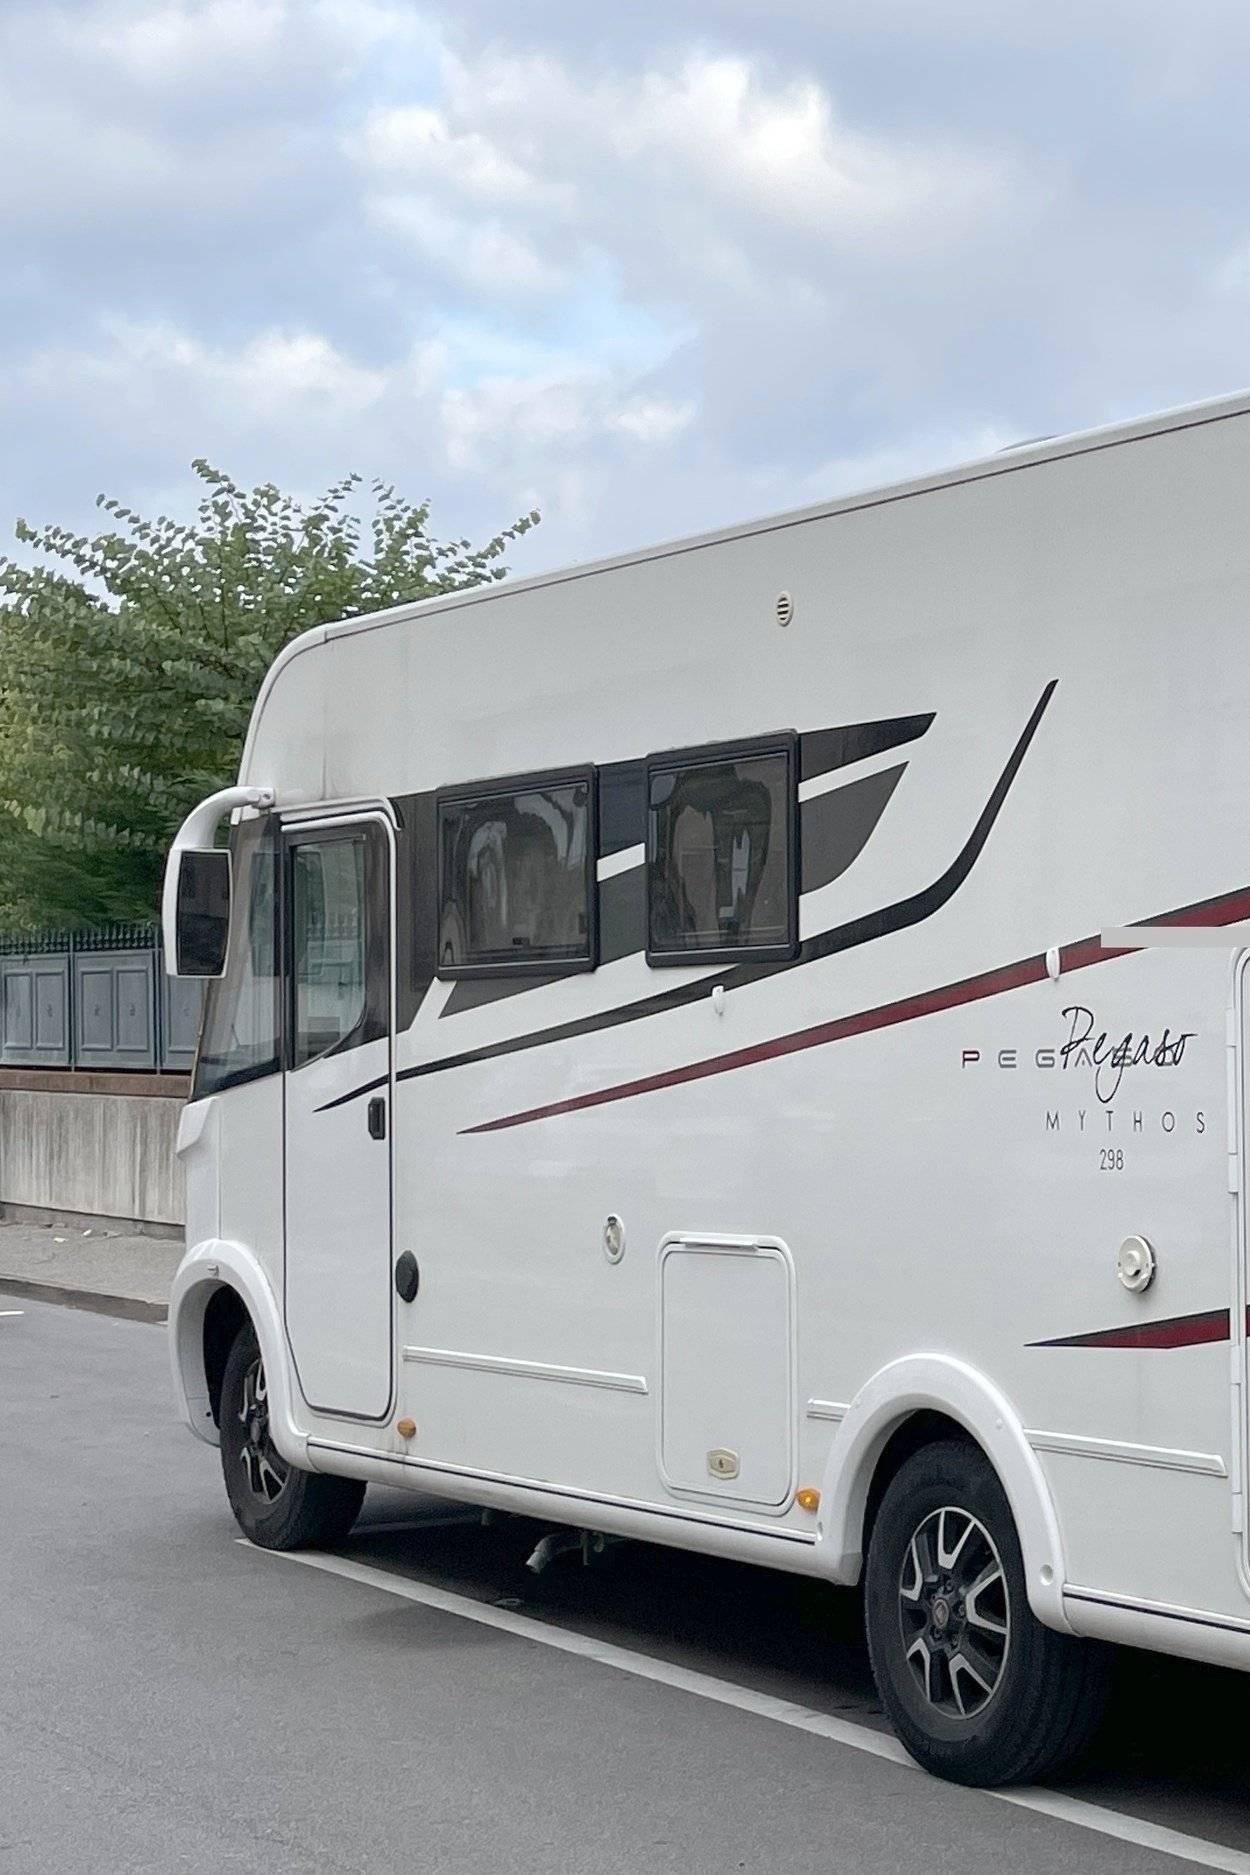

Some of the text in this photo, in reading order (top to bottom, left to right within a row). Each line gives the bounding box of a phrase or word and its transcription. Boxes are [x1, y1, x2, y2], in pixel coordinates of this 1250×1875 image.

[1060, 1006, 1198, 1104] Pegaso
[1046, 1110, 1207, 1134] MYTHOS
[1100, 1149, 1125, 1171] 298
